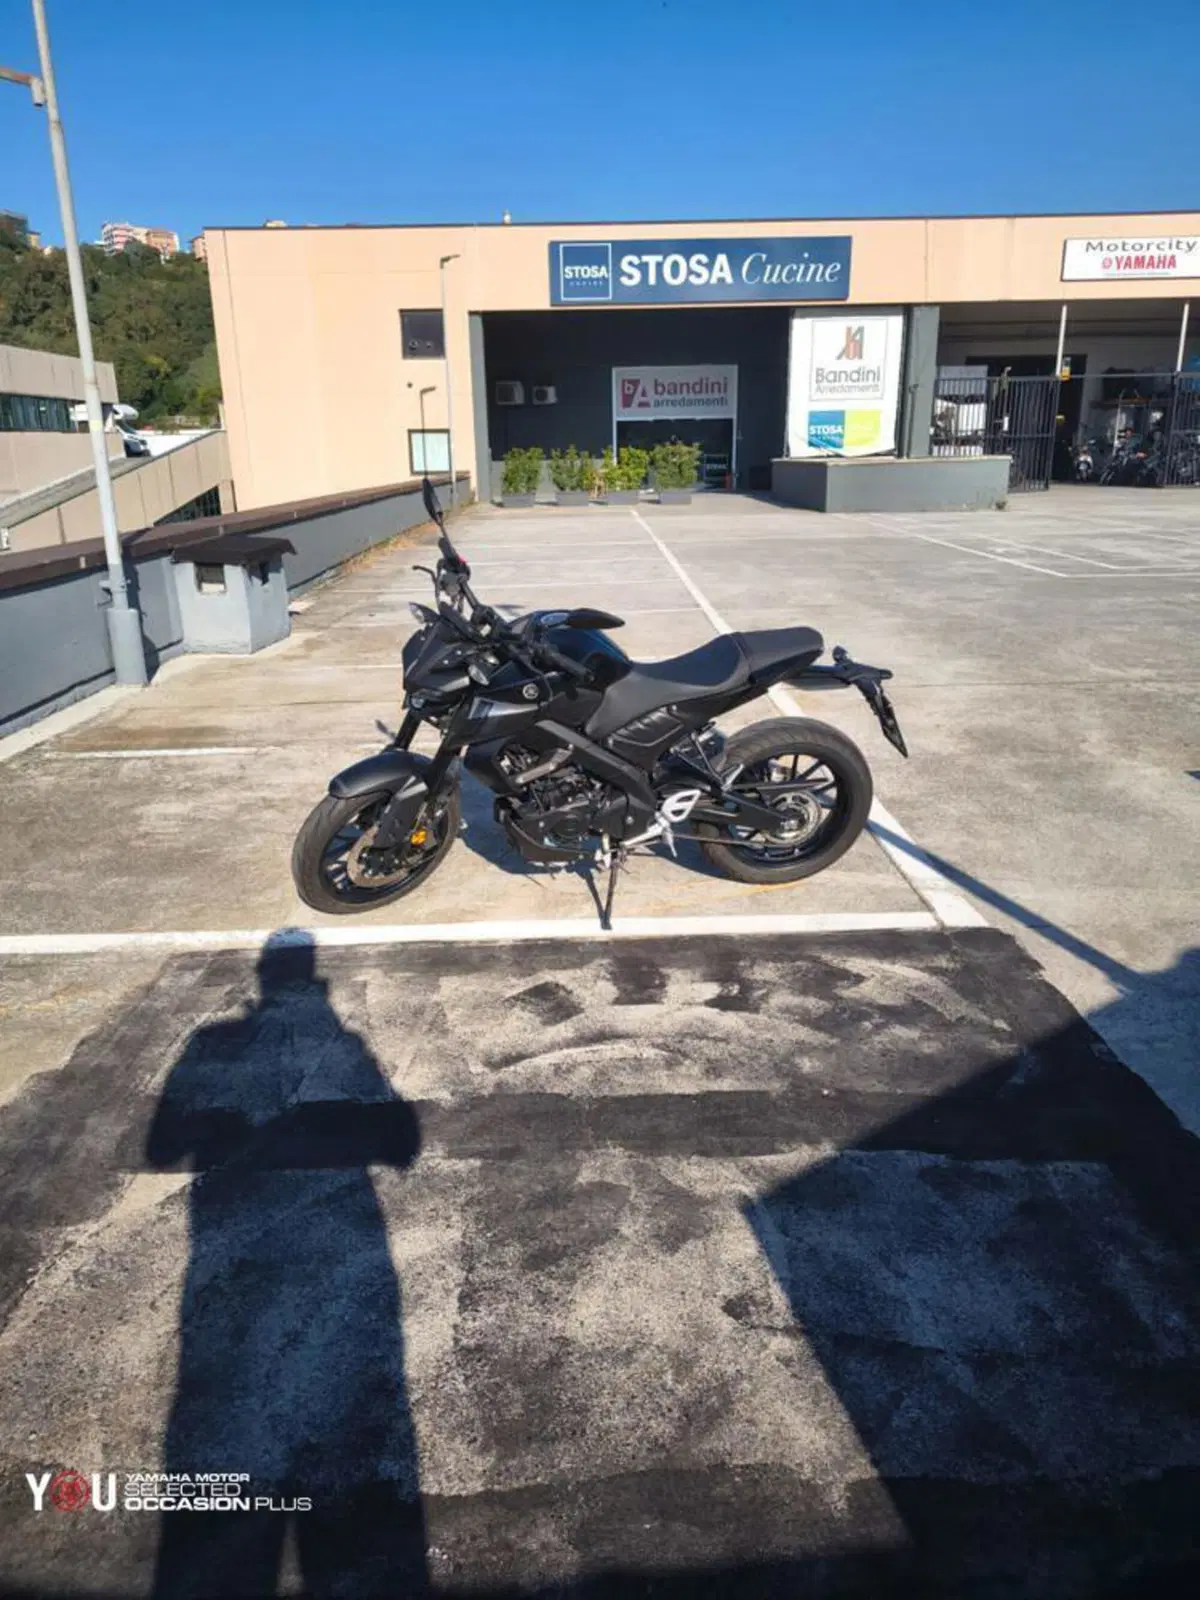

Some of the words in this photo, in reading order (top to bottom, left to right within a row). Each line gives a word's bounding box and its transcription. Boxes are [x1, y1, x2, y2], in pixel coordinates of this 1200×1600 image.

[1085, 239, 1198, 254] Motorcity
[619, 253, 734, 286] STOSA
[741, 252, 841, 284] Cucine
[1115, 254, 1177, 270] YAMAHA
[564, 265, 609, 279] STOSA
[815, 365, 881, 384] Bandini
[653, 377, 728, 396] bandini
[653, 396, 728, 408] arredamenti
